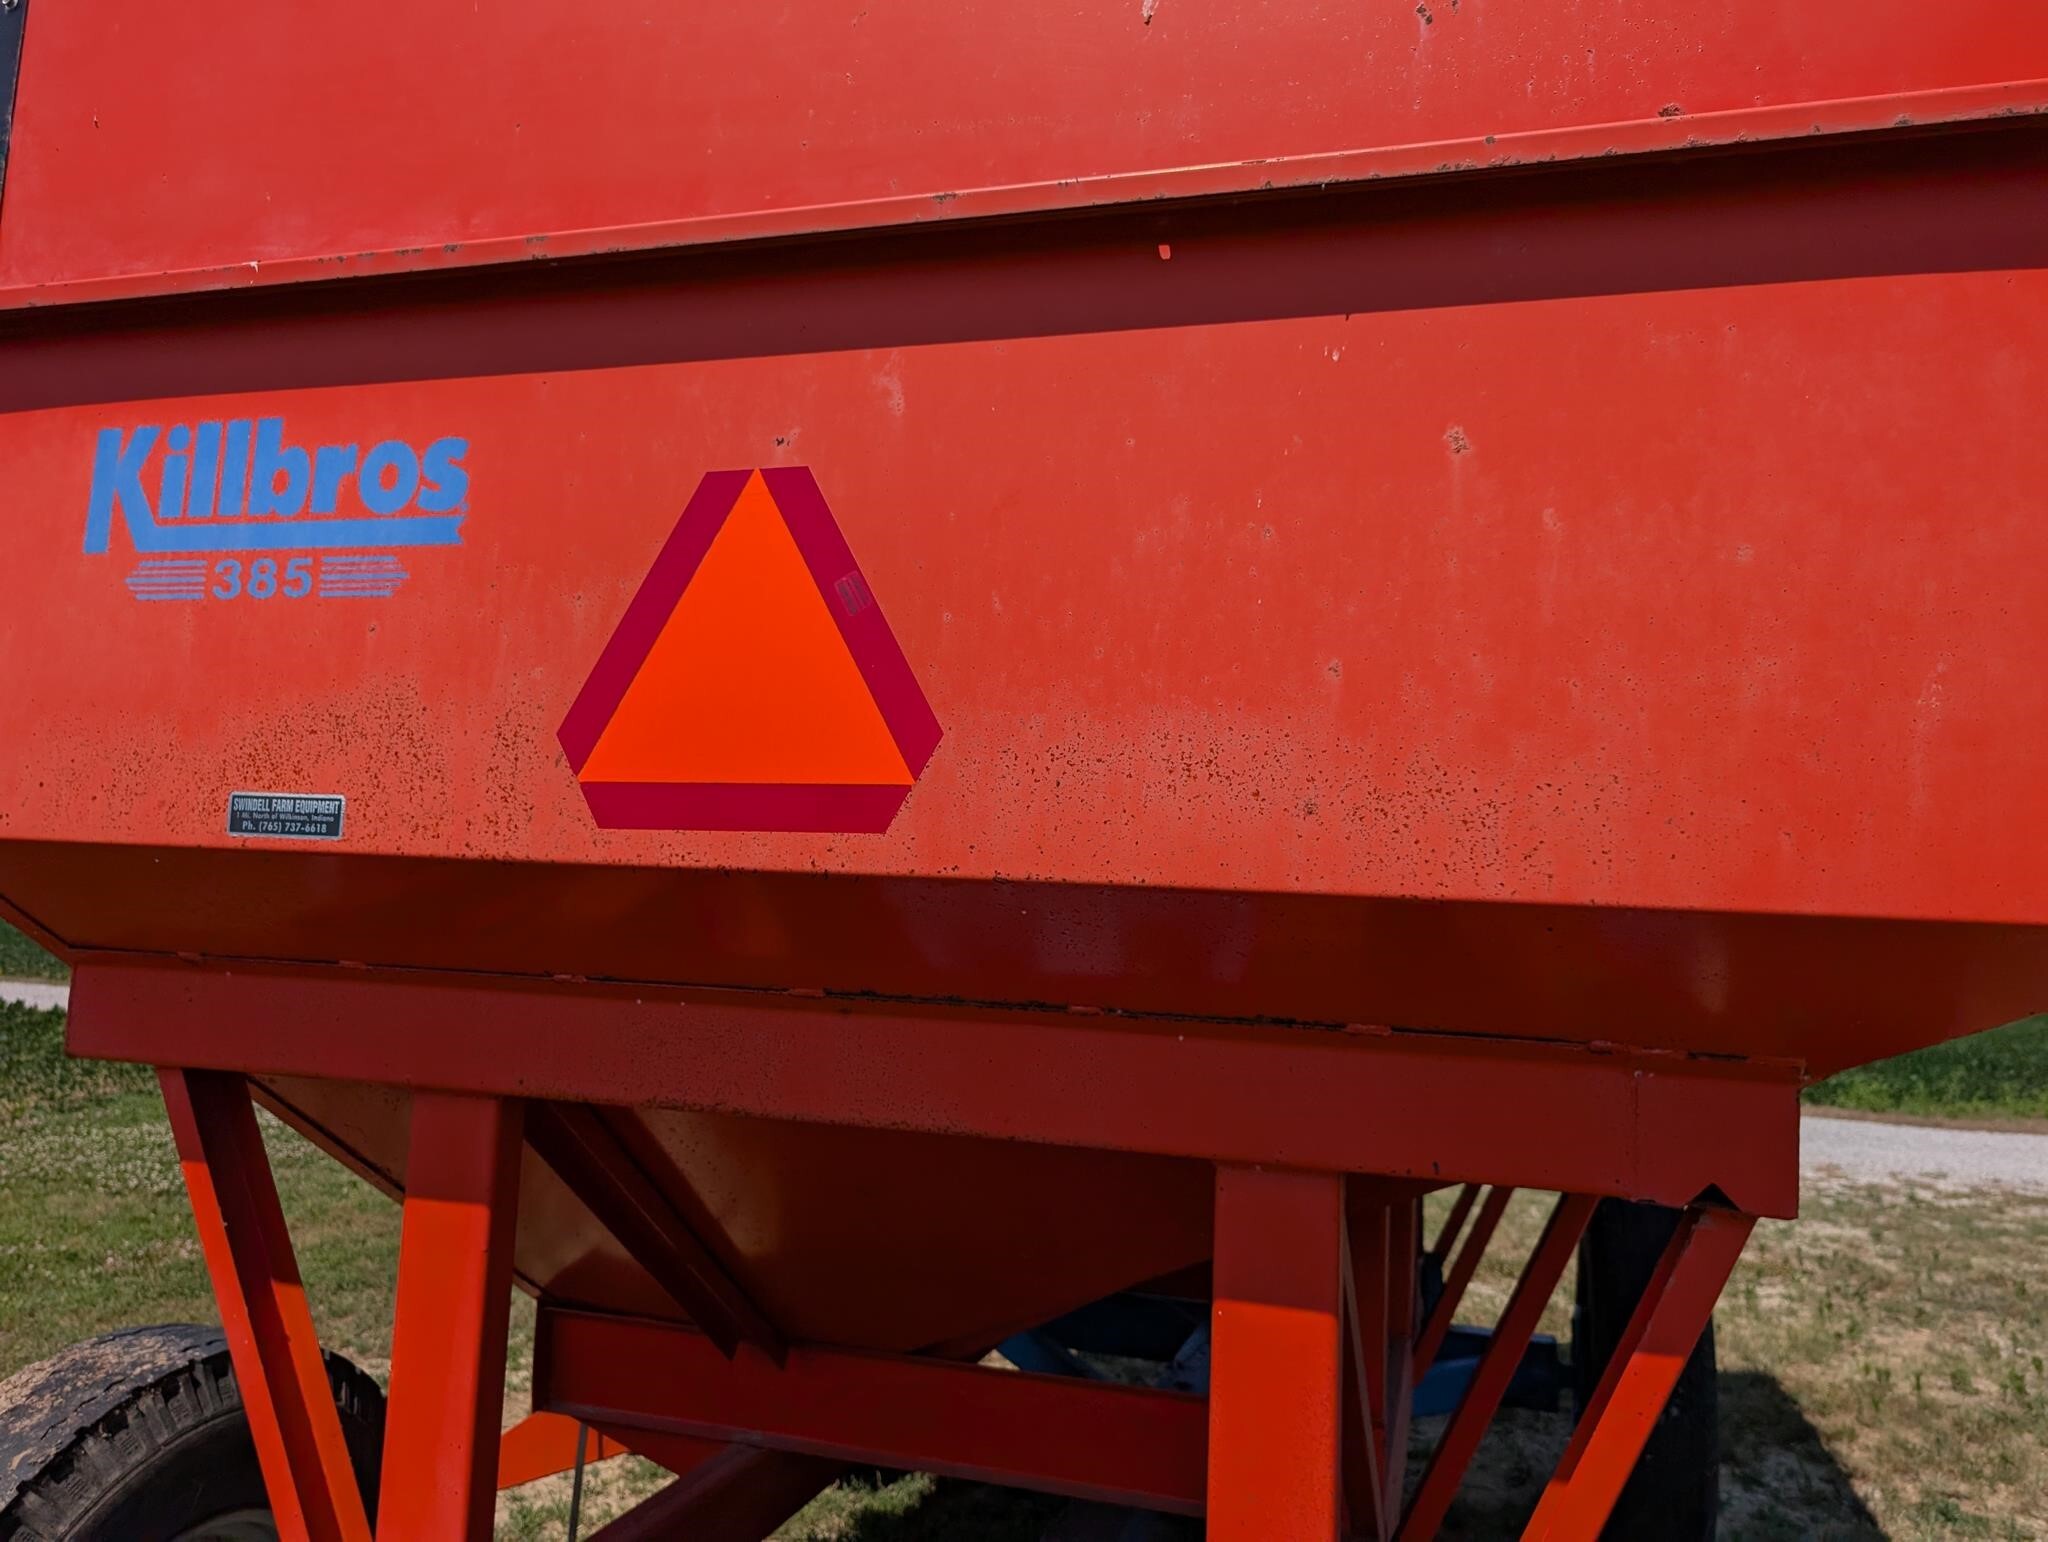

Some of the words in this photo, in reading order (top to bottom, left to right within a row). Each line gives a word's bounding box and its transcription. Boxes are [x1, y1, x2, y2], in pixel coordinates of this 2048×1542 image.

[83, 416, 470, 554] Killbros
[212, 557, 313, 600] 385
[233, 797, 270, 811] SWINDELL
[271, 798, 294, 812] FARM
[295, 799, 340, 815] EQUIPMENT
[253, 811, 270, 819] North
[271, 812, 278, 820] of
[242, 820, 256, 830] Ph.
[258, 821, 282, 833] (765)
[285, 822, 327, 833] 737-6618
